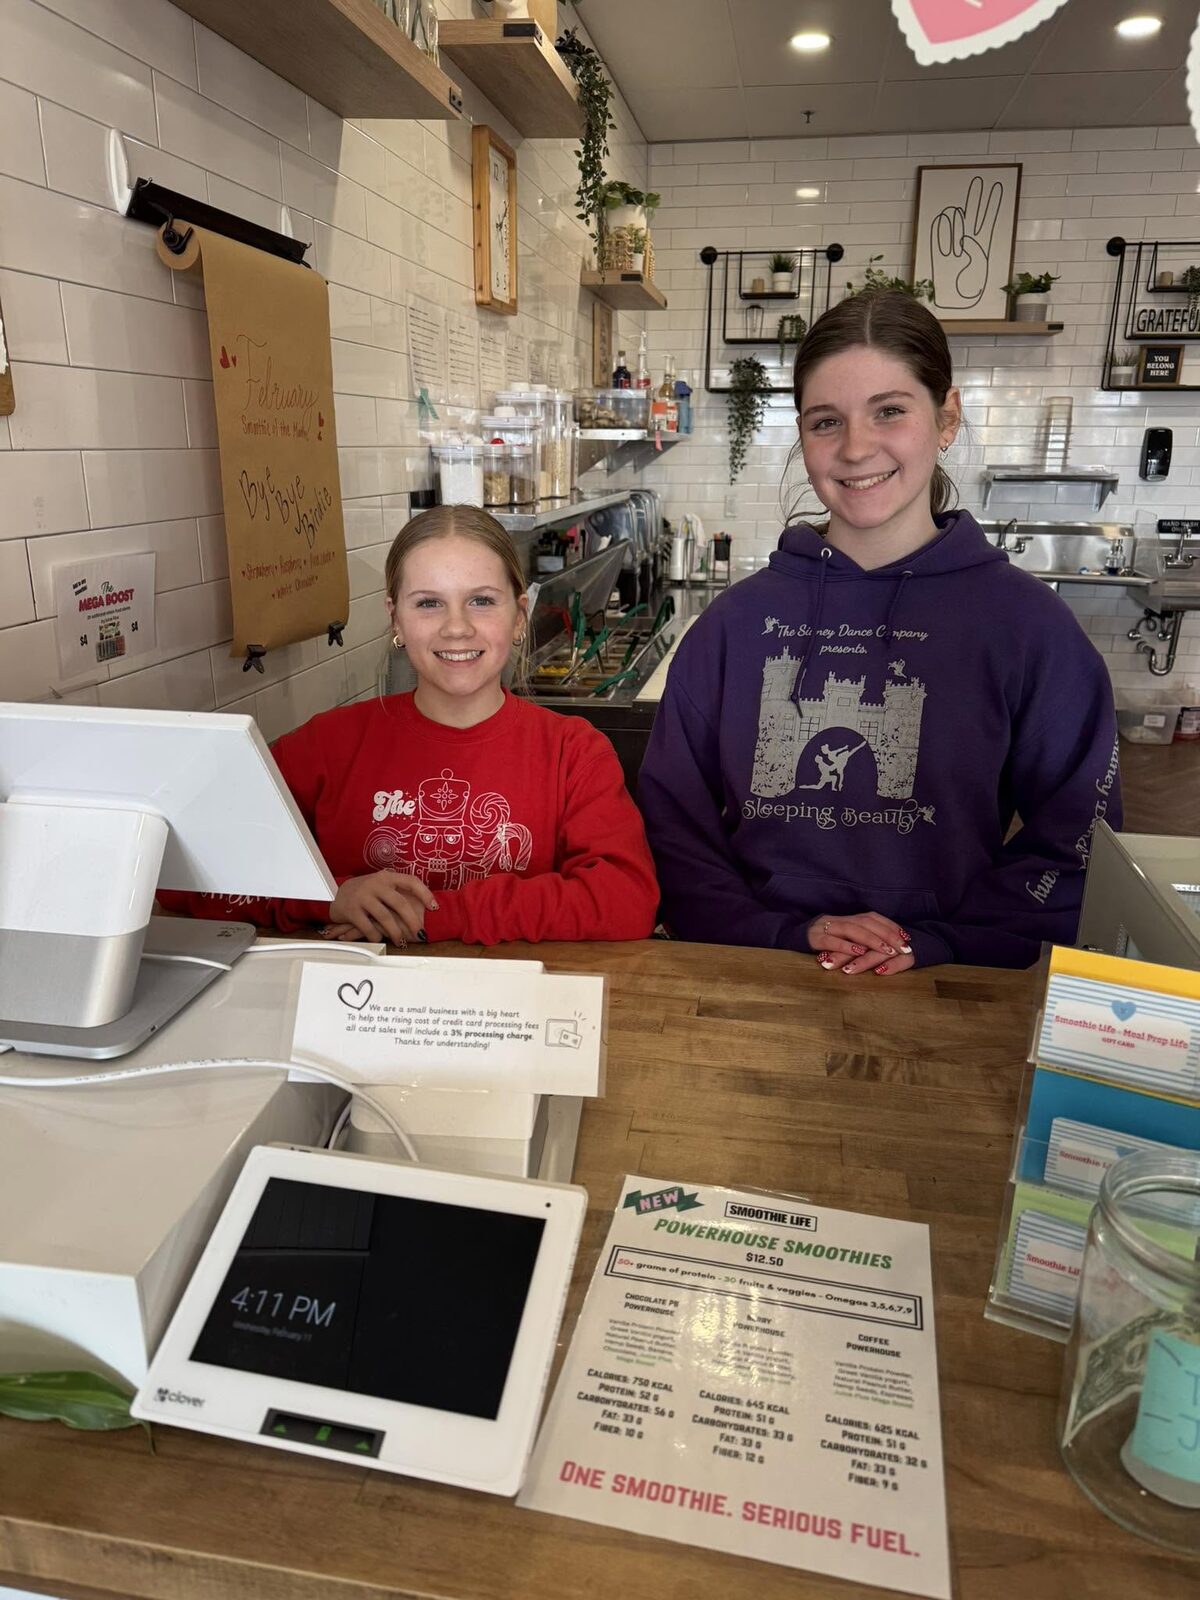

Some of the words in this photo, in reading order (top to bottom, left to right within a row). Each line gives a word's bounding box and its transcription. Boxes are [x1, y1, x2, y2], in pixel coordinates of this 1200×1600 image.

[1146, 362, 1175, 370] BELONG
[1154, 355, 1169, 363] YOU
[275, 475, 304, 534] Bye
[301, 487, 332, 549] Birdie
[101, 581, 113, 594] The
[79, 595, 104, 612] MEGA
[106, 589, 134, 606] BOOST
[778, 625, 796, 638] The
[838, 624, 873, 637] Dance
[372, 790, 417, 822] The
[742, 798, 837, 829] Sleeping
[841, 798, 920, 835] Beauty
[369, 1004, 381, 1012] We
[407, 1006, 426, 1014] small
[429, 1007, 458, 1015] business
[487, 1009, 498, 1019] big
[500, 1010, 519, 1018] heart
[358, 1013, 374, 1023] help
[391, 1016, 412, 1025] rising
[415, 1017, 429, 1025] cost
[432, 1017, 440, 1025] of
[465, 1019, 482, 1027] card
[485, 1021, 522, 1031] processing
[525, 1022, 539, 1030] fees
[345, 1024, 356, 1032] all
[358, 1025, 376, 1033] card
[379, 1026, 397, 1034] sales
[415, 1028, 440, 1036] include
[450, 1029, 462, 1037] 3%
[464, 1030, 505, 1041] processing
[506, 1031, 534, 1042] charge.
[1055, 1015, 1097, 1031] Smoothie
[1098, 1024, 1116, 1034] Life
[1123, 1029, 1145, 1040] Meal
[1170, 1038, 1189, 1050] Life
[395, 1037, 420, 1046] Thanks
[423, 1039, 434, 1047] for
[436, 1040, 491, 1051] understanding!
[1058, 1150, 1100, 1169] Smoothie
[639, 1190, 679, 1210] NEW
[729, 1205, 787, 1224] SMOOTHIE
[789, 1215, 812, 1229] LIFE
[653, 1218, 780, 1250] POWERHOUSE
[783, 1239, 893, 1270] SMOOTHIES
[746, 1252, 784, 1268] $12.50
[1026, 1253, 1067, 1272] Smoothie
[636, 1261, 667, 1272] grams
[669, 1267, 680, 1275] of
[681, 1269, 716, 1281] protein
[739, 1279, 765, 1290] fruits
[776, 1286, 816, 1298] veggies
[825, 1293, 868, 1307] Omegas
[230, 1286, 284, 1317] 4:11
[288, 1295, 336, 1328] PM
[625, 1292, 666, 1305] CHOCOLATE
[624, 1302, 676, 1317] POWERHOUSE
[858, 1334, 890, 1346] COFFEE
[846, 1341, 902, 1359] POWERHOUSE
[587, 1368, 629, 1383] CALORIES:
[632, 1376, 650, 1387] 750
[651, 1381, 673, 1392] KCAL
[169, 1390, 205, 1408] clover
[598, 1383, 636, 1397] PROTEIN:
[639, 1390, 651, 1400] 52
[577, 1391, 652, 1414] CARBOHYDRATES:
[654, 1406, 666, 1417] 56
[699, 1390, 744, 1406] CALORIES:
[746, 1399, 765, 1410] 645
[767, 1403, 790, 1415] KCAL
[601, 1409, 620, 1420] FAT:
[622, 1413, 634, 1423] 33
[713, 1405, 753, 1420] PROTEIN:
[756, 1413, 767, 1423] 51
[593, 1421, 622, 1435] FIBER:
[692, 1414, 770, 1437] CARBOHYDRATES:
[773, 1429, 785, 1440] 33
[825, 1413, 872, 1431] CALORIES:
[874, 1424, 893, 1435] 625
[895, 1428, 920, 1440] KCAL
[719, 1432, 738, 1445] FAT:
[741, 1437, 753, 1447] 33
[841, 1430, 883, 1446] PROTEIN:
[886, 1438, 897, 1449] 51
[712, 1445, 742, 1460] FIBER:
[745, 1451, 756, 1462] 12
[820, 1439, 902, 1464] CARBOHYDRATES:
[905, 1455, 918, 1467] 32
[851, 1459, 871, 1472] FAT:
[874, 1463, 886, 1474] 33
[848, 1472, 880, 1488] FIBER:
[882, 1480, 889, 1489] 9
[559, 1460, 605, 1490] ONE
[611, 1473, 733, 1518] SMOOTHIE.
[741, 1500, 842, 1540] SERIOUS
[850, 1522, 921, 1558] FUEL.
